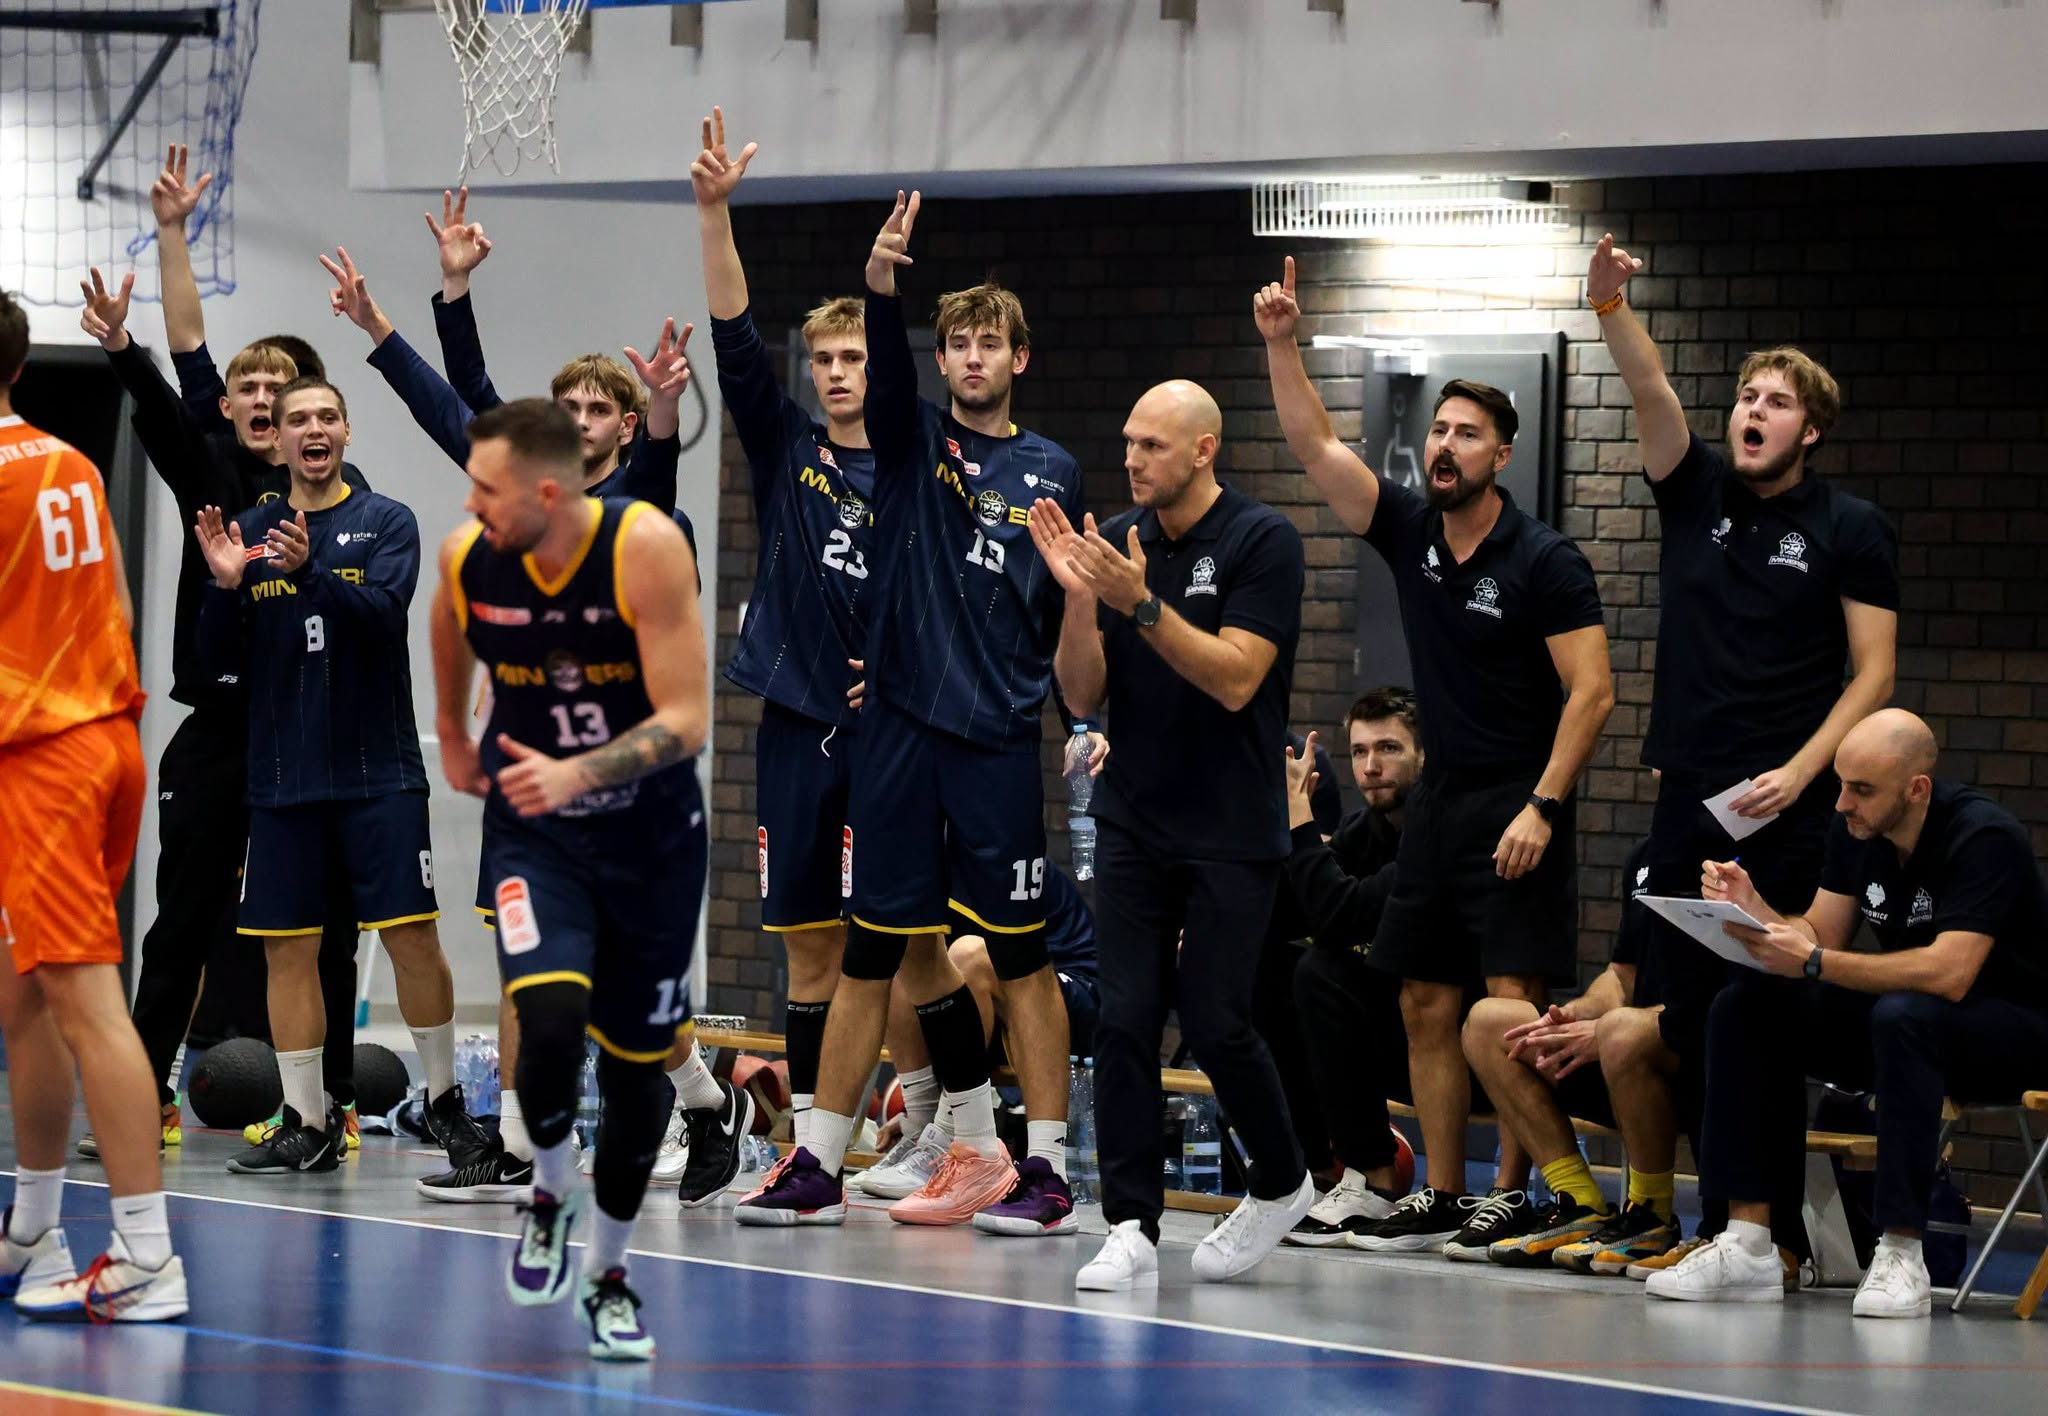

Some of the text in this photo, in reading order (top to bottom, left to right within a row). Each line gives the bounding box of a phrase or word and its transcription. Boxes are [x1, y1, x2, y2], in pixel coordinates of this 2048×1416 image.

[37, 481, 104, 572] 61
[304, 615, 325, 653] 8
[550, 701, 611, 748] 13
[418, 850, 433, 889] 8
[1010, 857, 1044, 900] 19
